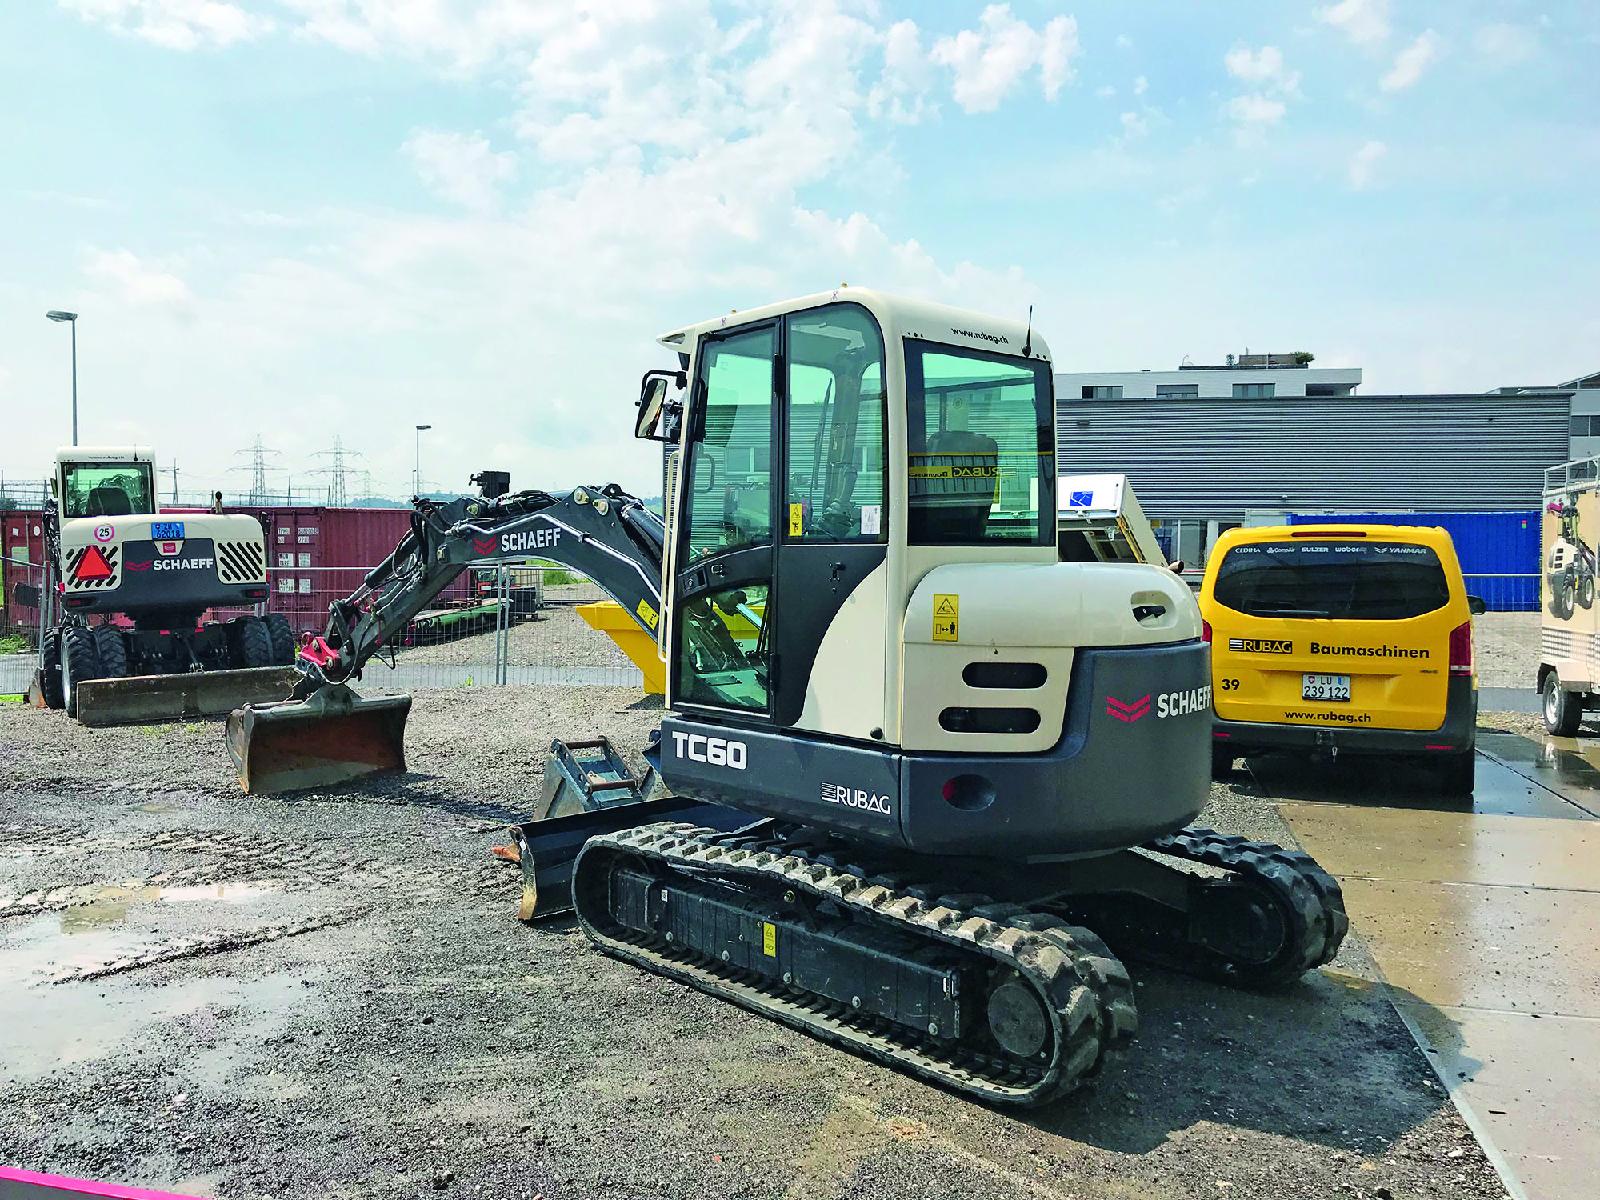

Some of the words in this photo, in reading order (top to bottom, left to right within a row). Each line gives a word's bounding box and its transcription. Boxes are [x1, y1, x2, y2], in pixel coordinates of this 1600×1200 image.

[99, 528, 110, 537] 25
[501, 527, 562, 552] SCHAEFF
[153, 558, 214, 571] SCHAEFF
[1243, 640, 1292, 653] RUBAG
[1310, 642, 1430, 659] Baumaschinen
[1221, 678, 1240, 690] 39
[1320, 676, 1332, 685] LU
[1304, 686, 1324, 697] 239
[1329, 687, 1348, 699] 122
[1157, 685, 1211, 718] SCHAEFF
[1284, 710, 1371, 723] www.rubag.ch
[672, 731, 747, 770] TC60
[836, 786, 891, 815] RUBAG
